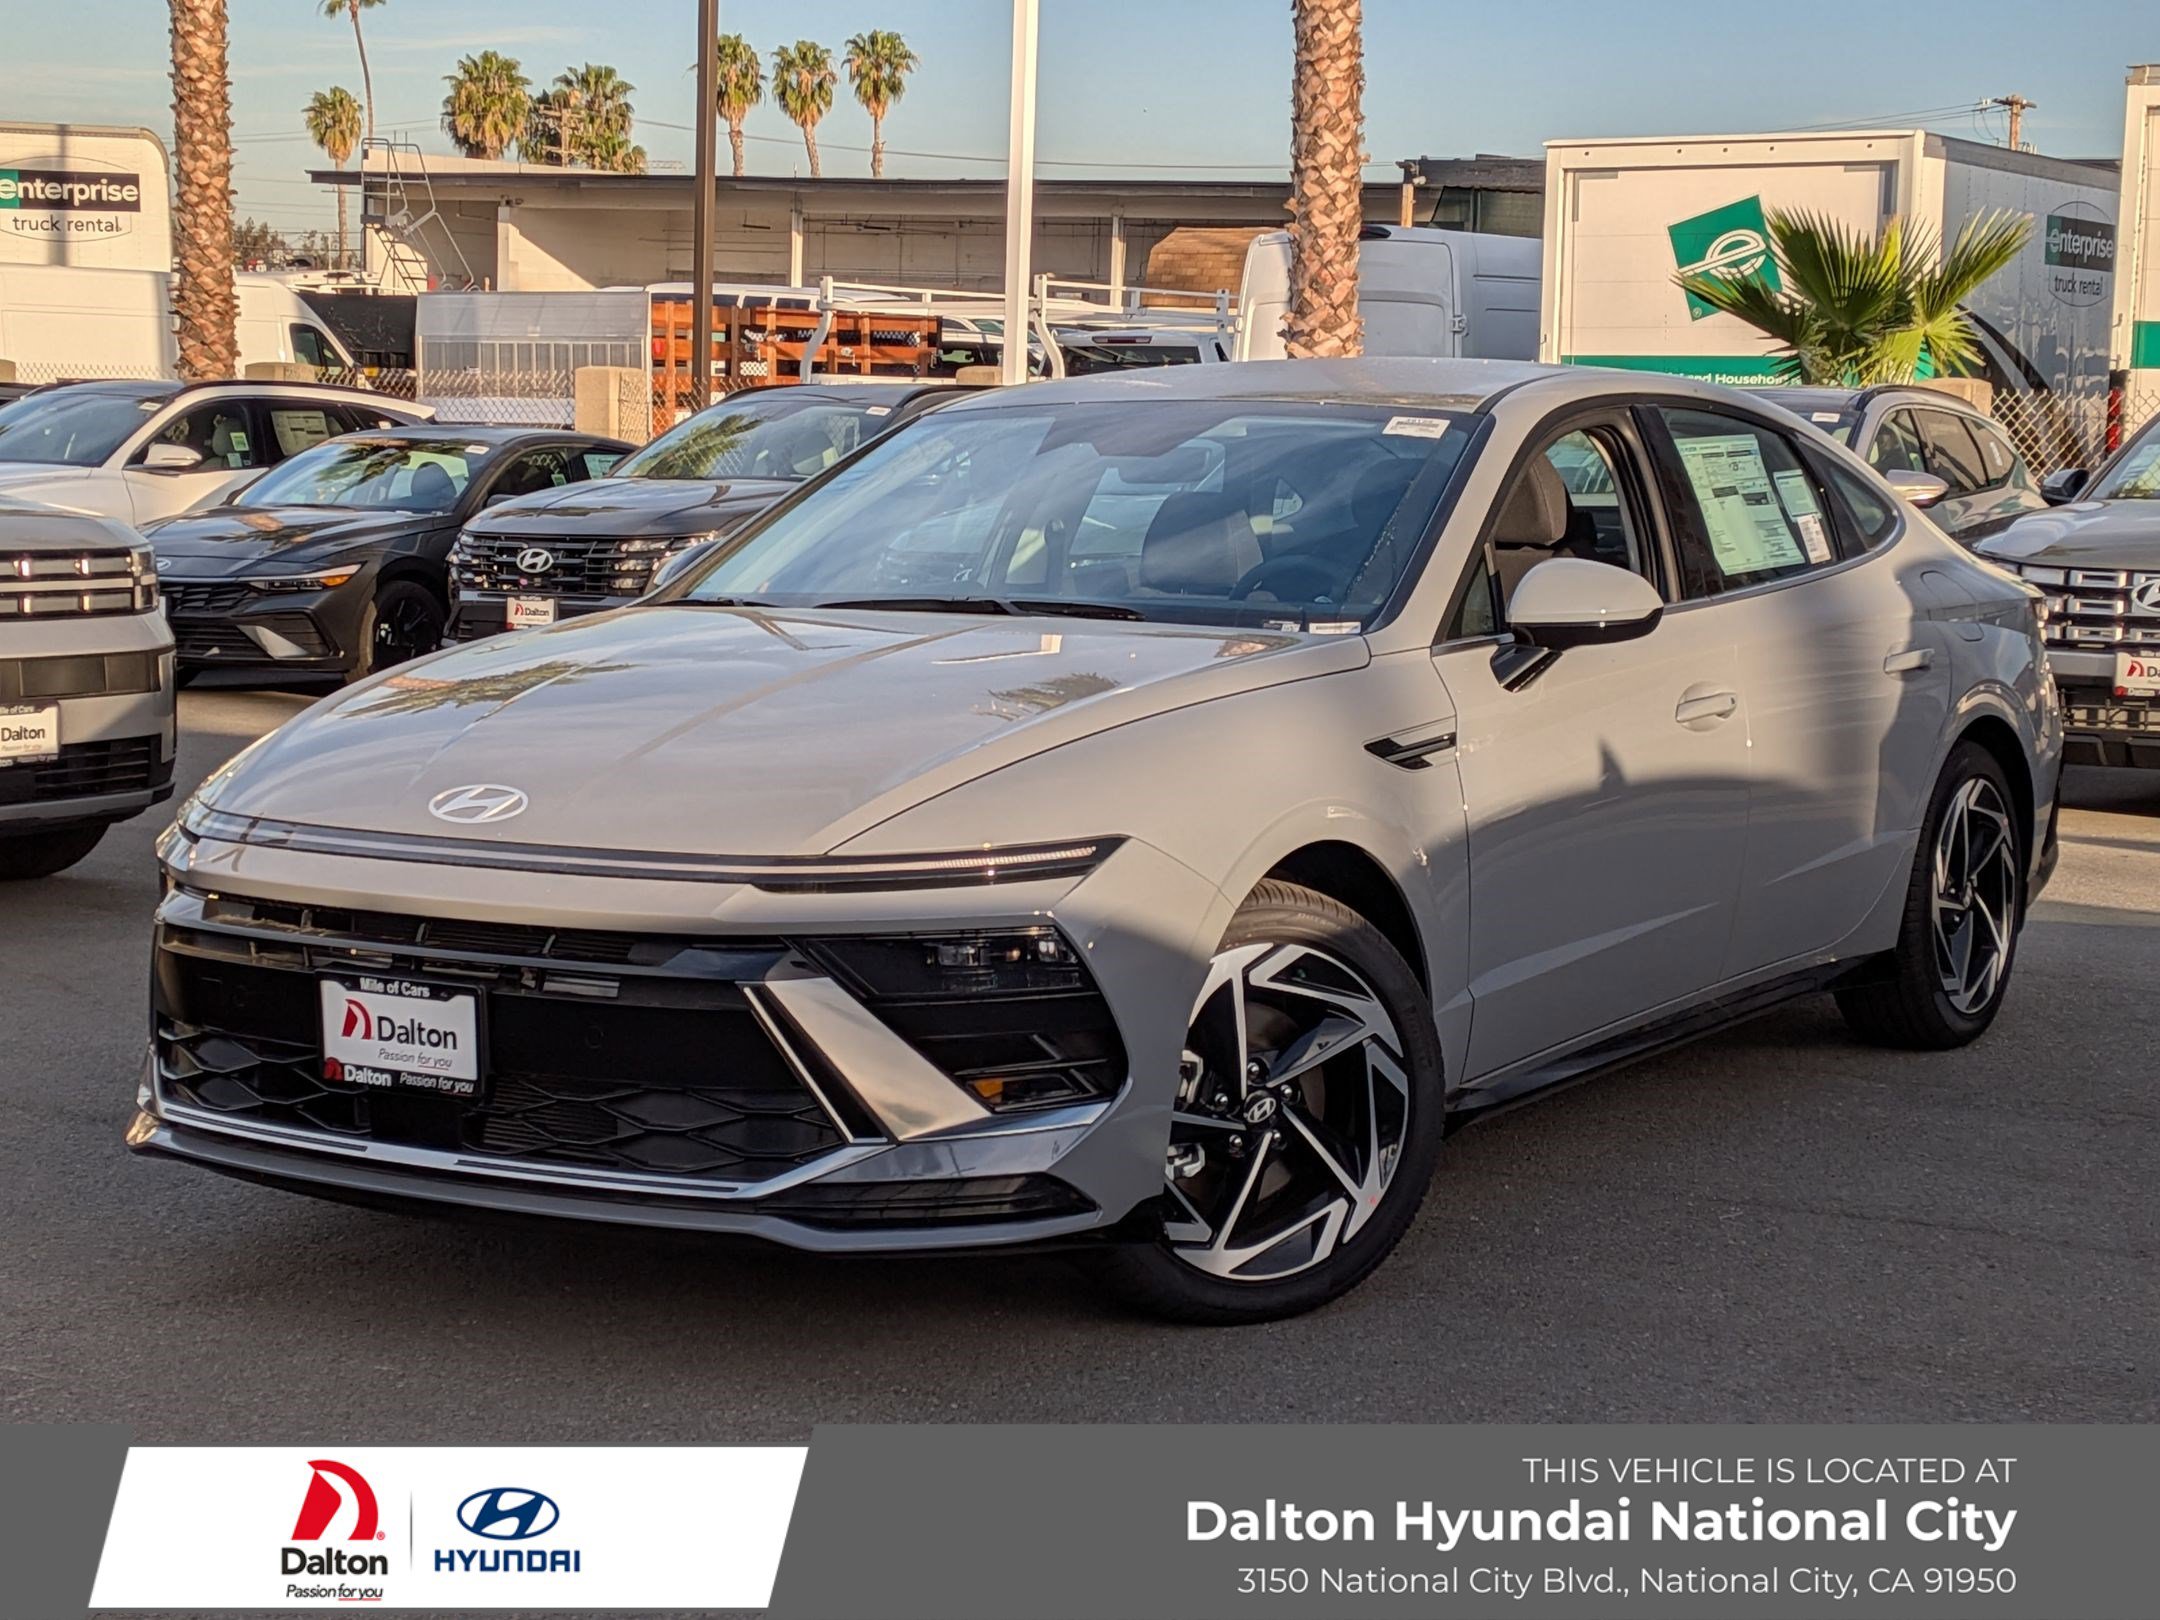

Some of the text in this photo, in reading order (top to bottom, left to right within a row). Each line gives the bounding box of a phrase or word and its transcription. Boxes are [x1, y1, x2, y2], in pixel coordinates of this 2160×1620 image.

[0, 178, 139, 207] enterprise
[12, 214, 120, 233] truck rental
[2046, 228, 2114, 263] enterprise
[2055, 272, 2104, 296] truck rental
[525, 607, 549, 616] Dalton
[1, 726, 45, 741] Dalton
[360, 977, 430, 998] Mile of Cars
[377, 1015, 458, 1050] Dalton
[378, 1048, 453, 1068] Passion for you
[344, 1064, 474, 1094] Dalton Passion for you
